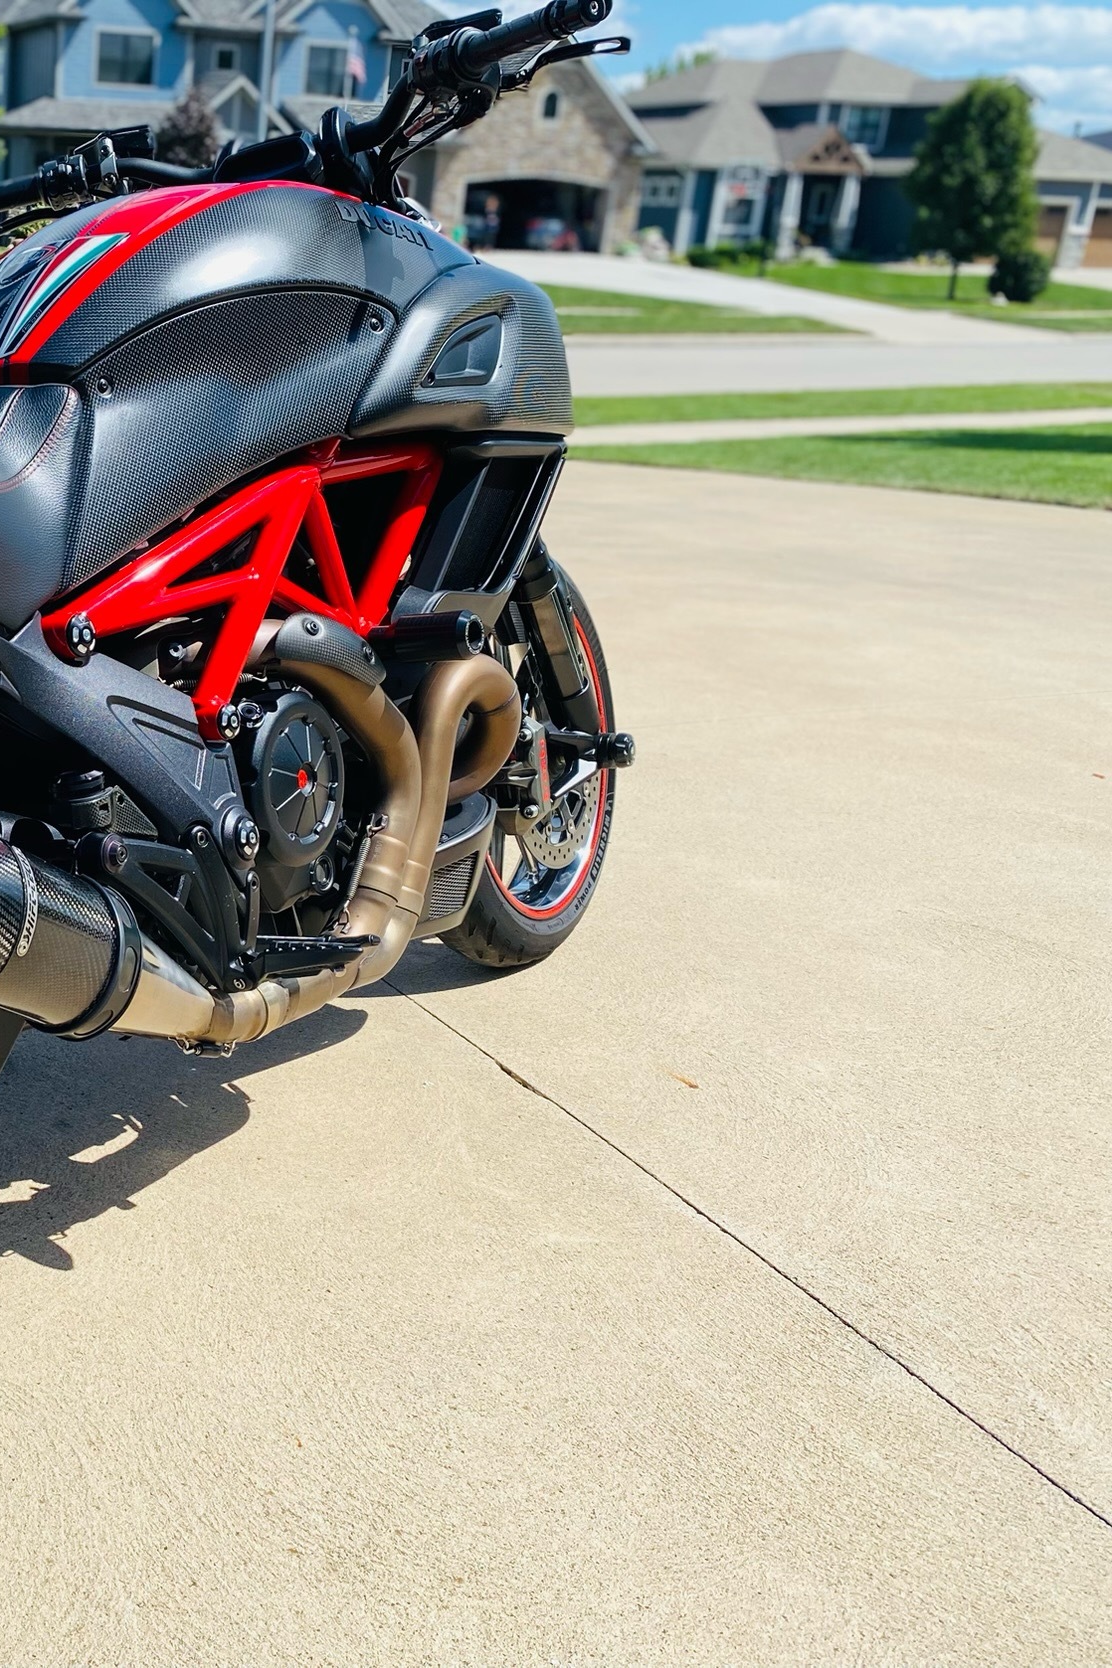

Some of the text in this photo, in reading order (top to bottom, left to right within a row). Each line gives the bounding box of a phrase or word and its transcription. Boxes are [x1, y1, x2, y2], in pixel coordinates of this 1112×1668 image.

[334, 201, 434, 252] DUCATI
[592, 811, 612, 878] MICHELIN
[575, 882, 592, 911] POWER
